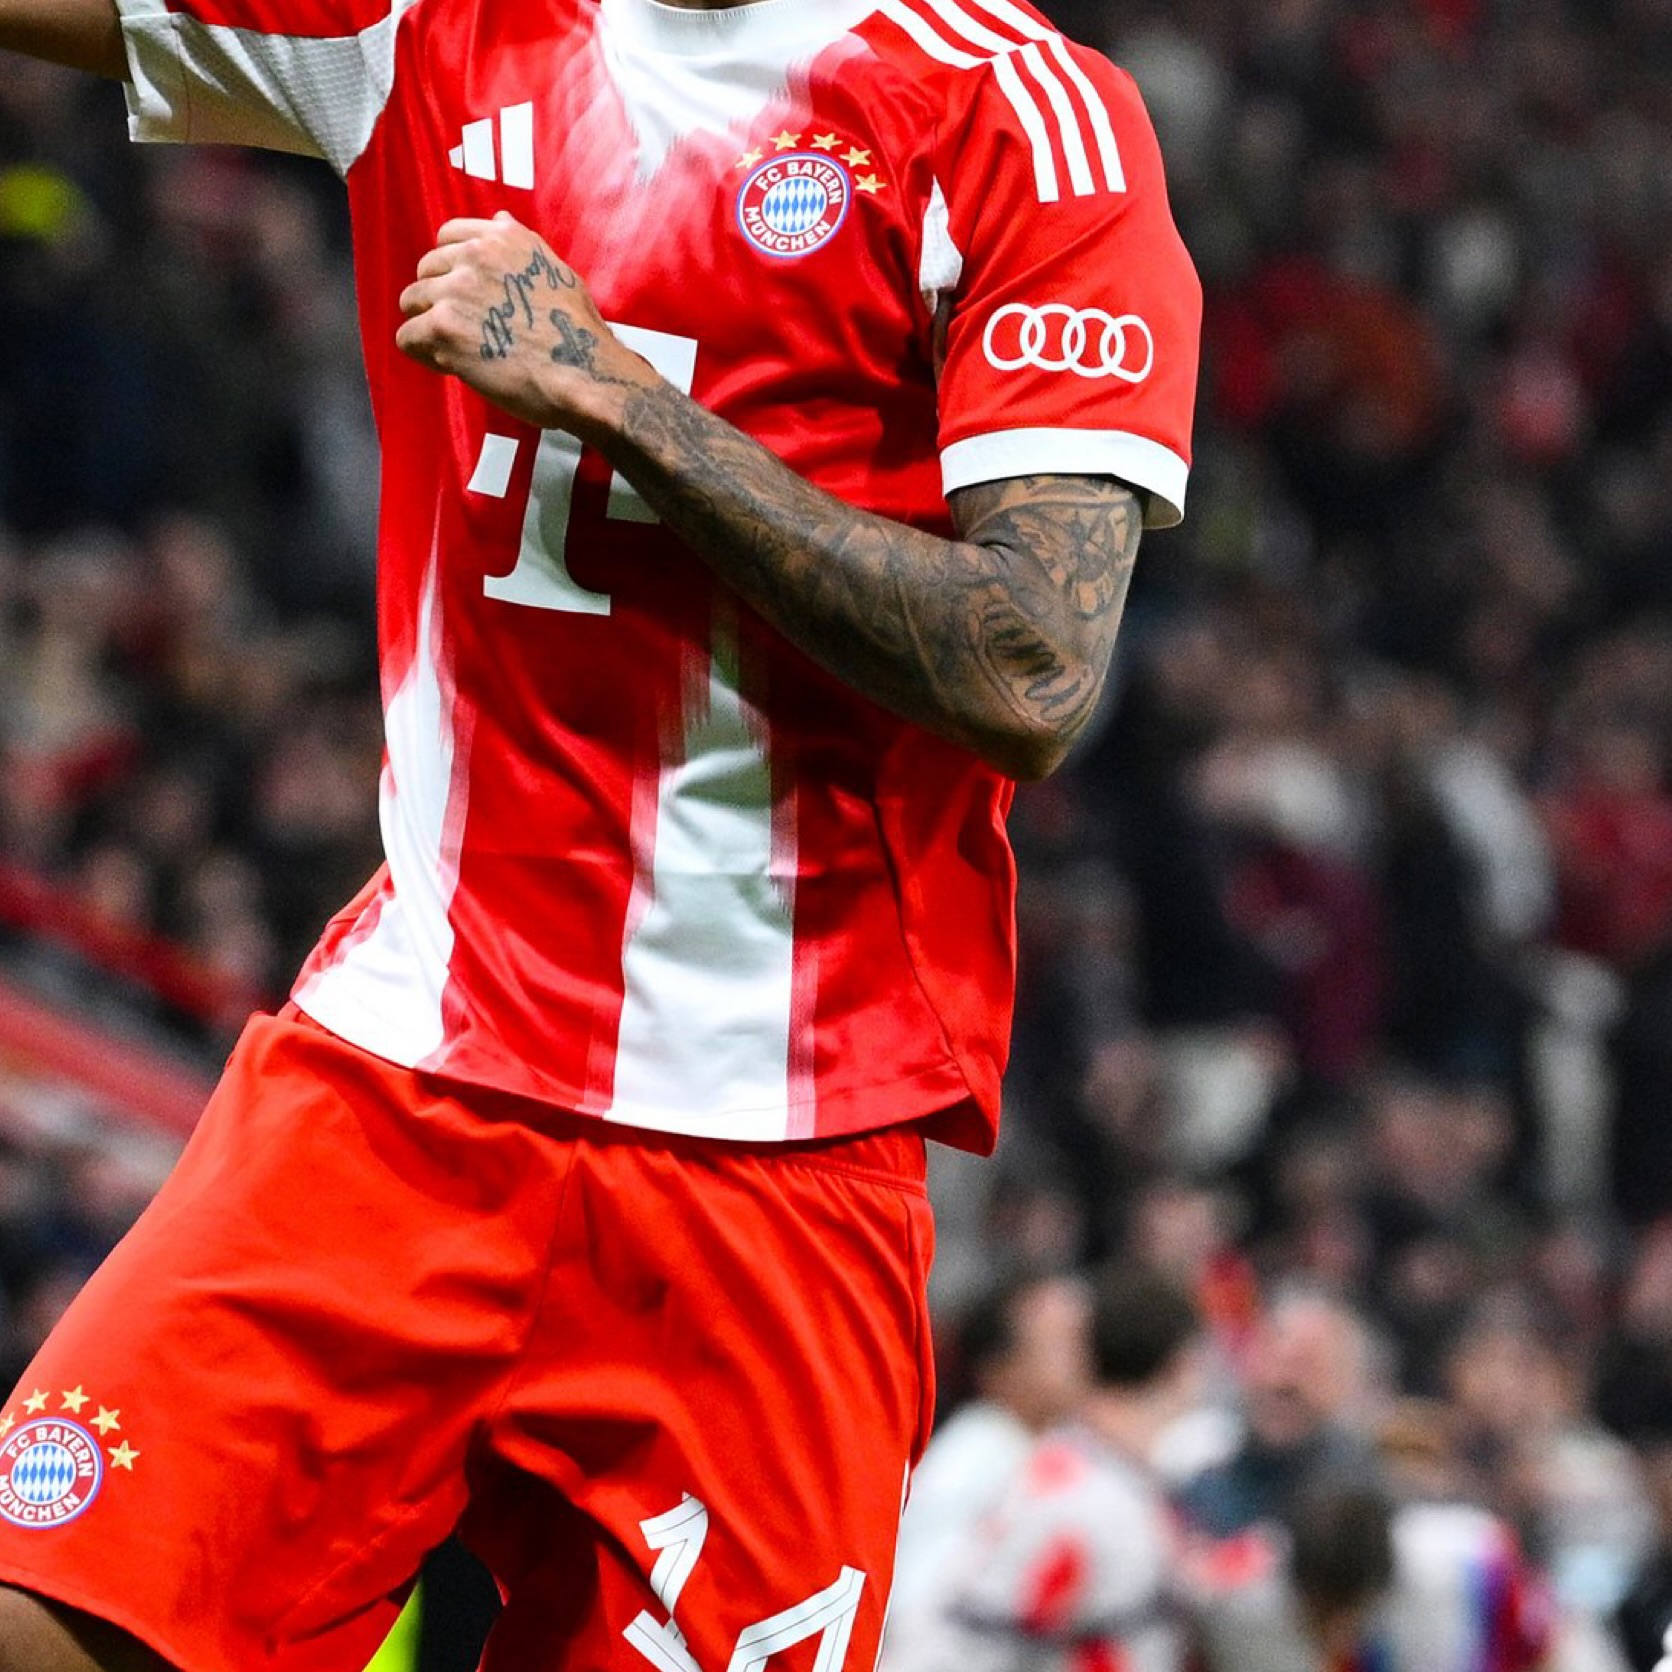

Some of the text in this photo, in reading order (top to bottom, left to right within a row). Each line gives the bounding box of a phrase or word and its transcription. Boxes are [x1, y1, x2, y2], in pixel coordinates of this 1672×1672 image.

[755, 161, 842, 205] FC BAYERN
[6, 1426, 94, 1477] FC BAYERN
